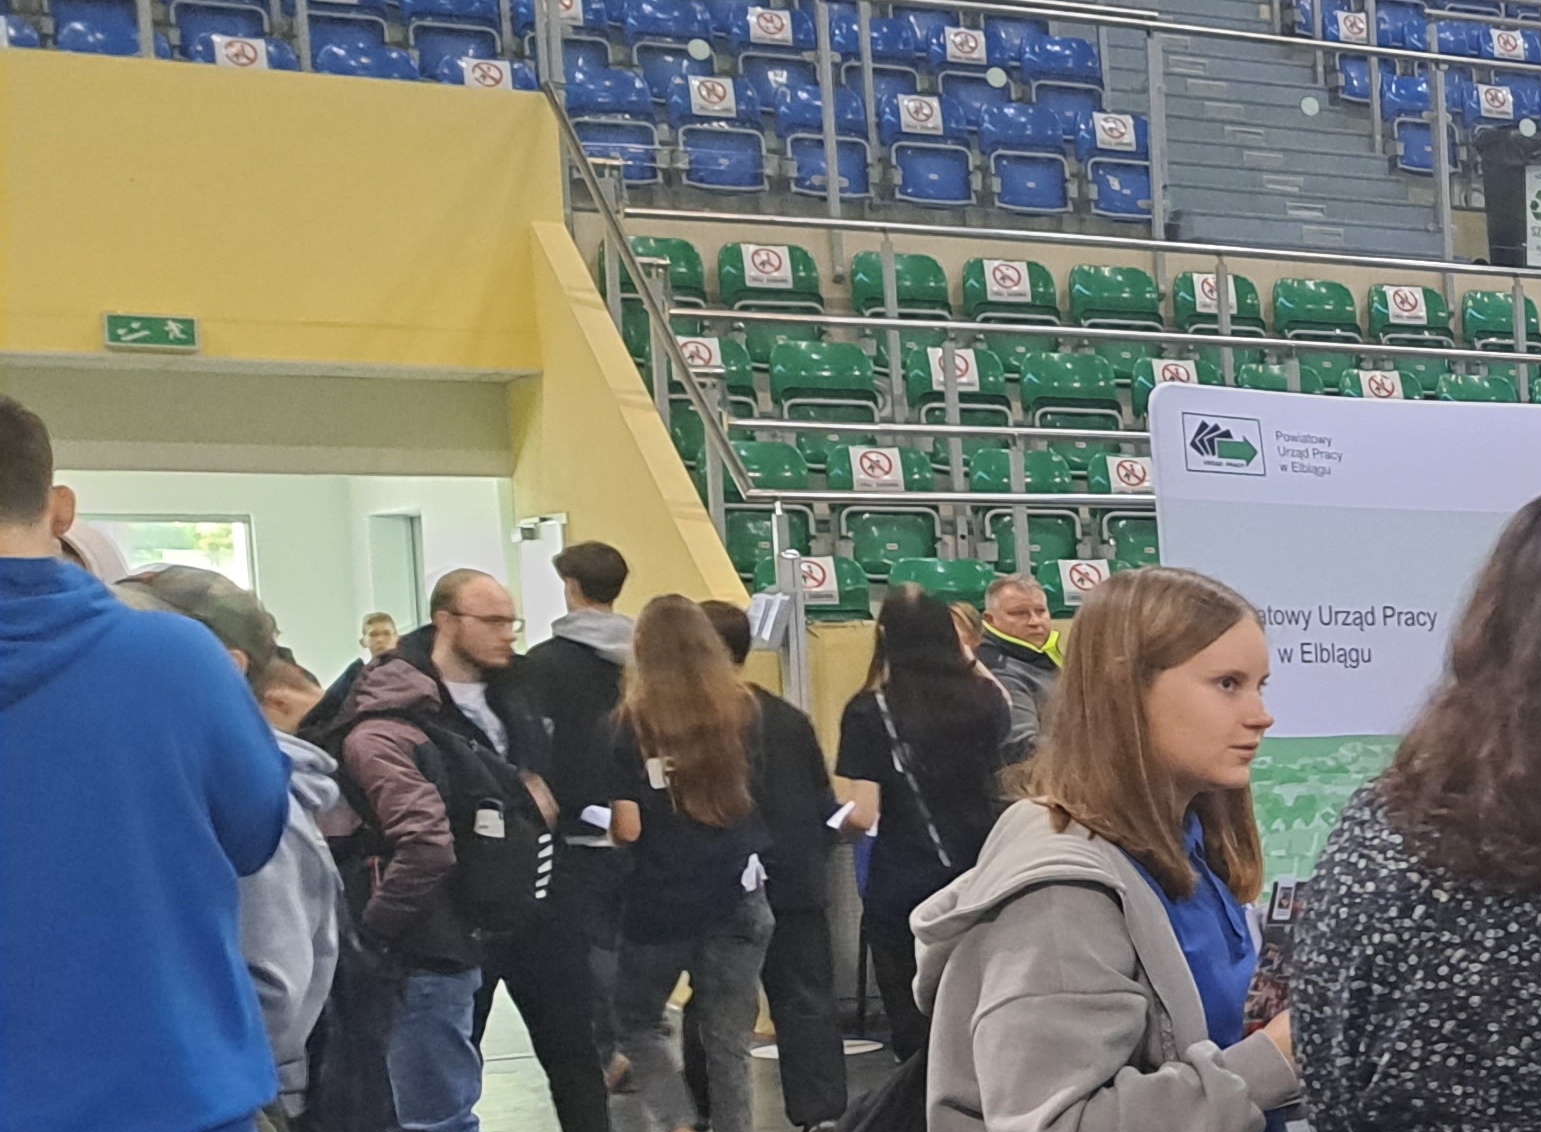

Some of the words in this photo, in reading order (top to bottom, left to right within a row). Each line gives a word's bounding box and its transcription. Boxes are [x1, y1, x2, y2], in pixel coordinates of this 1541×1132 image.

[1275, 430, 1332, 447] Powiatowy
[1312, 447, 1342, 462] Pracy
[1258, 606, 1312, 631] atowy
[1319, 605, 1375, 631] Urząd
[1382, 606, 1437, 631] Pracy
[1278, 648, 1292, 663] w
[1300, 643, 1371, 668] Elblągu
